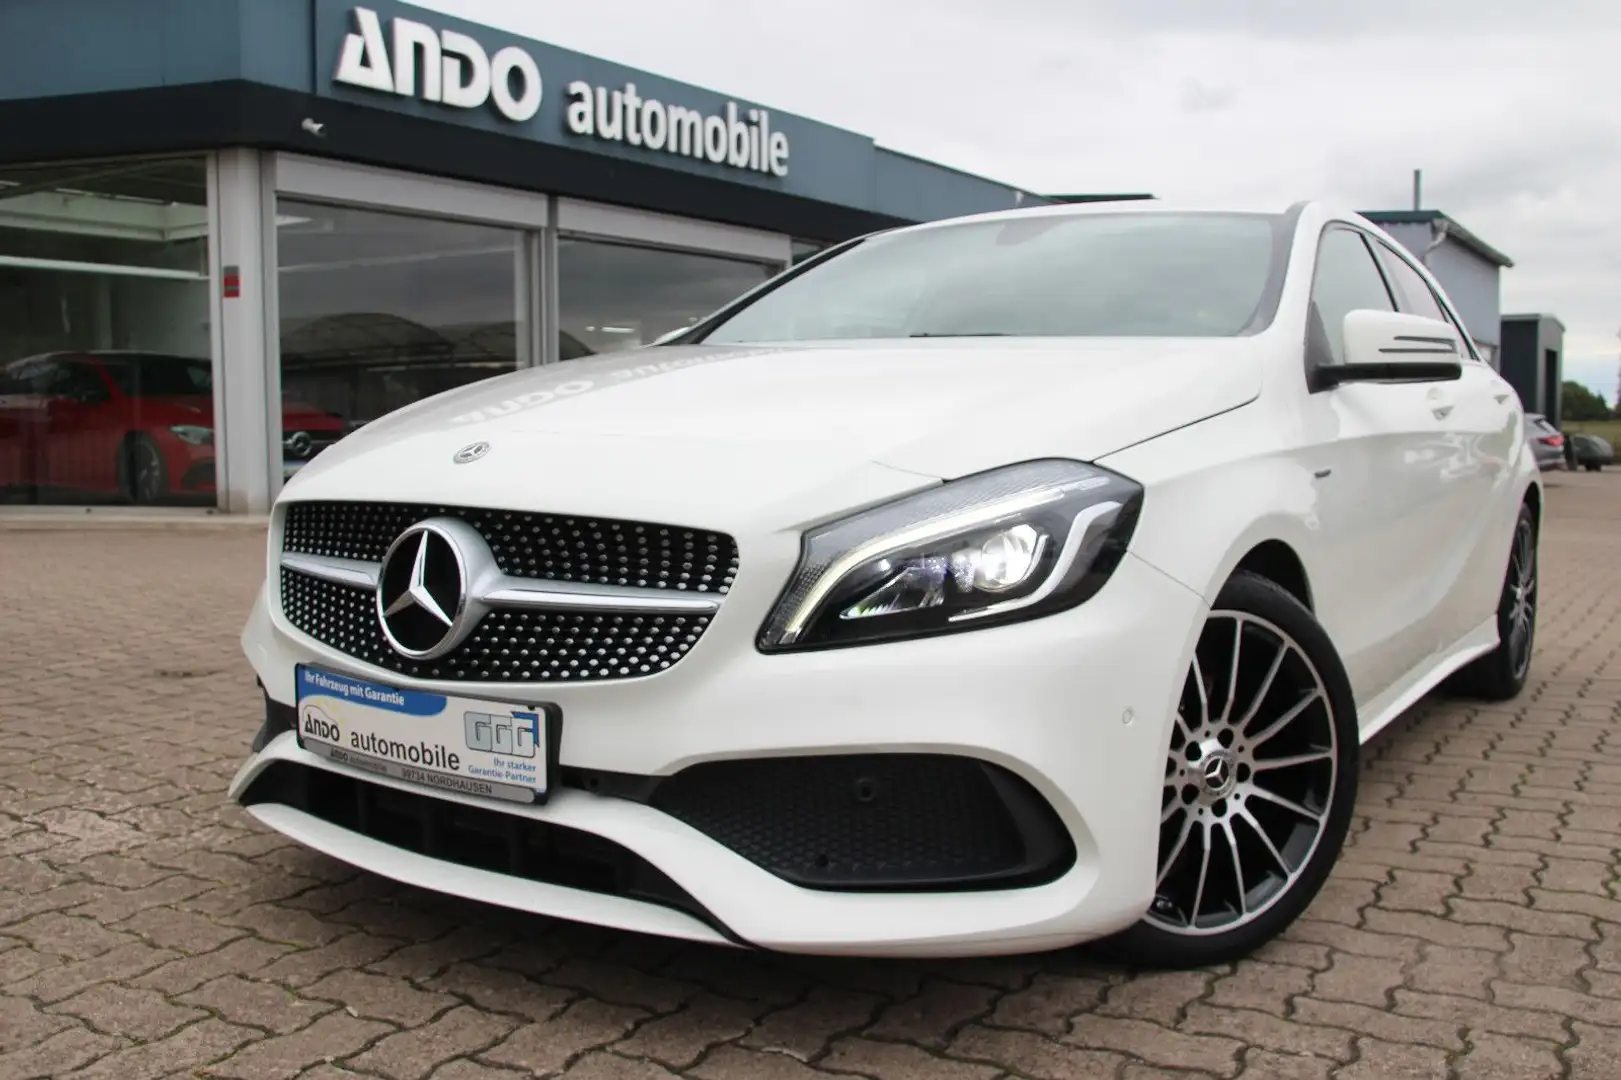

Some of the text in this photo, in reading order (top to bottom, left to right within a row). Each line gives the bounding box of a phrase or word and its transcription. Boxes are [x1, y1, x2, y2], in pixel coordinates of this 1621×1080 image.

[333, 7, 788, 177] ANDO automobile
[304, 671, 405, 706] Ihr Fahrzeug mit Garantie
[305, 714, 340, 742] ANDO
[351, 730, 460, 771] automobile
[493, 757, 537, 772] Ihr starker
[425, 773, 493, 795] NORDHAUSEN
